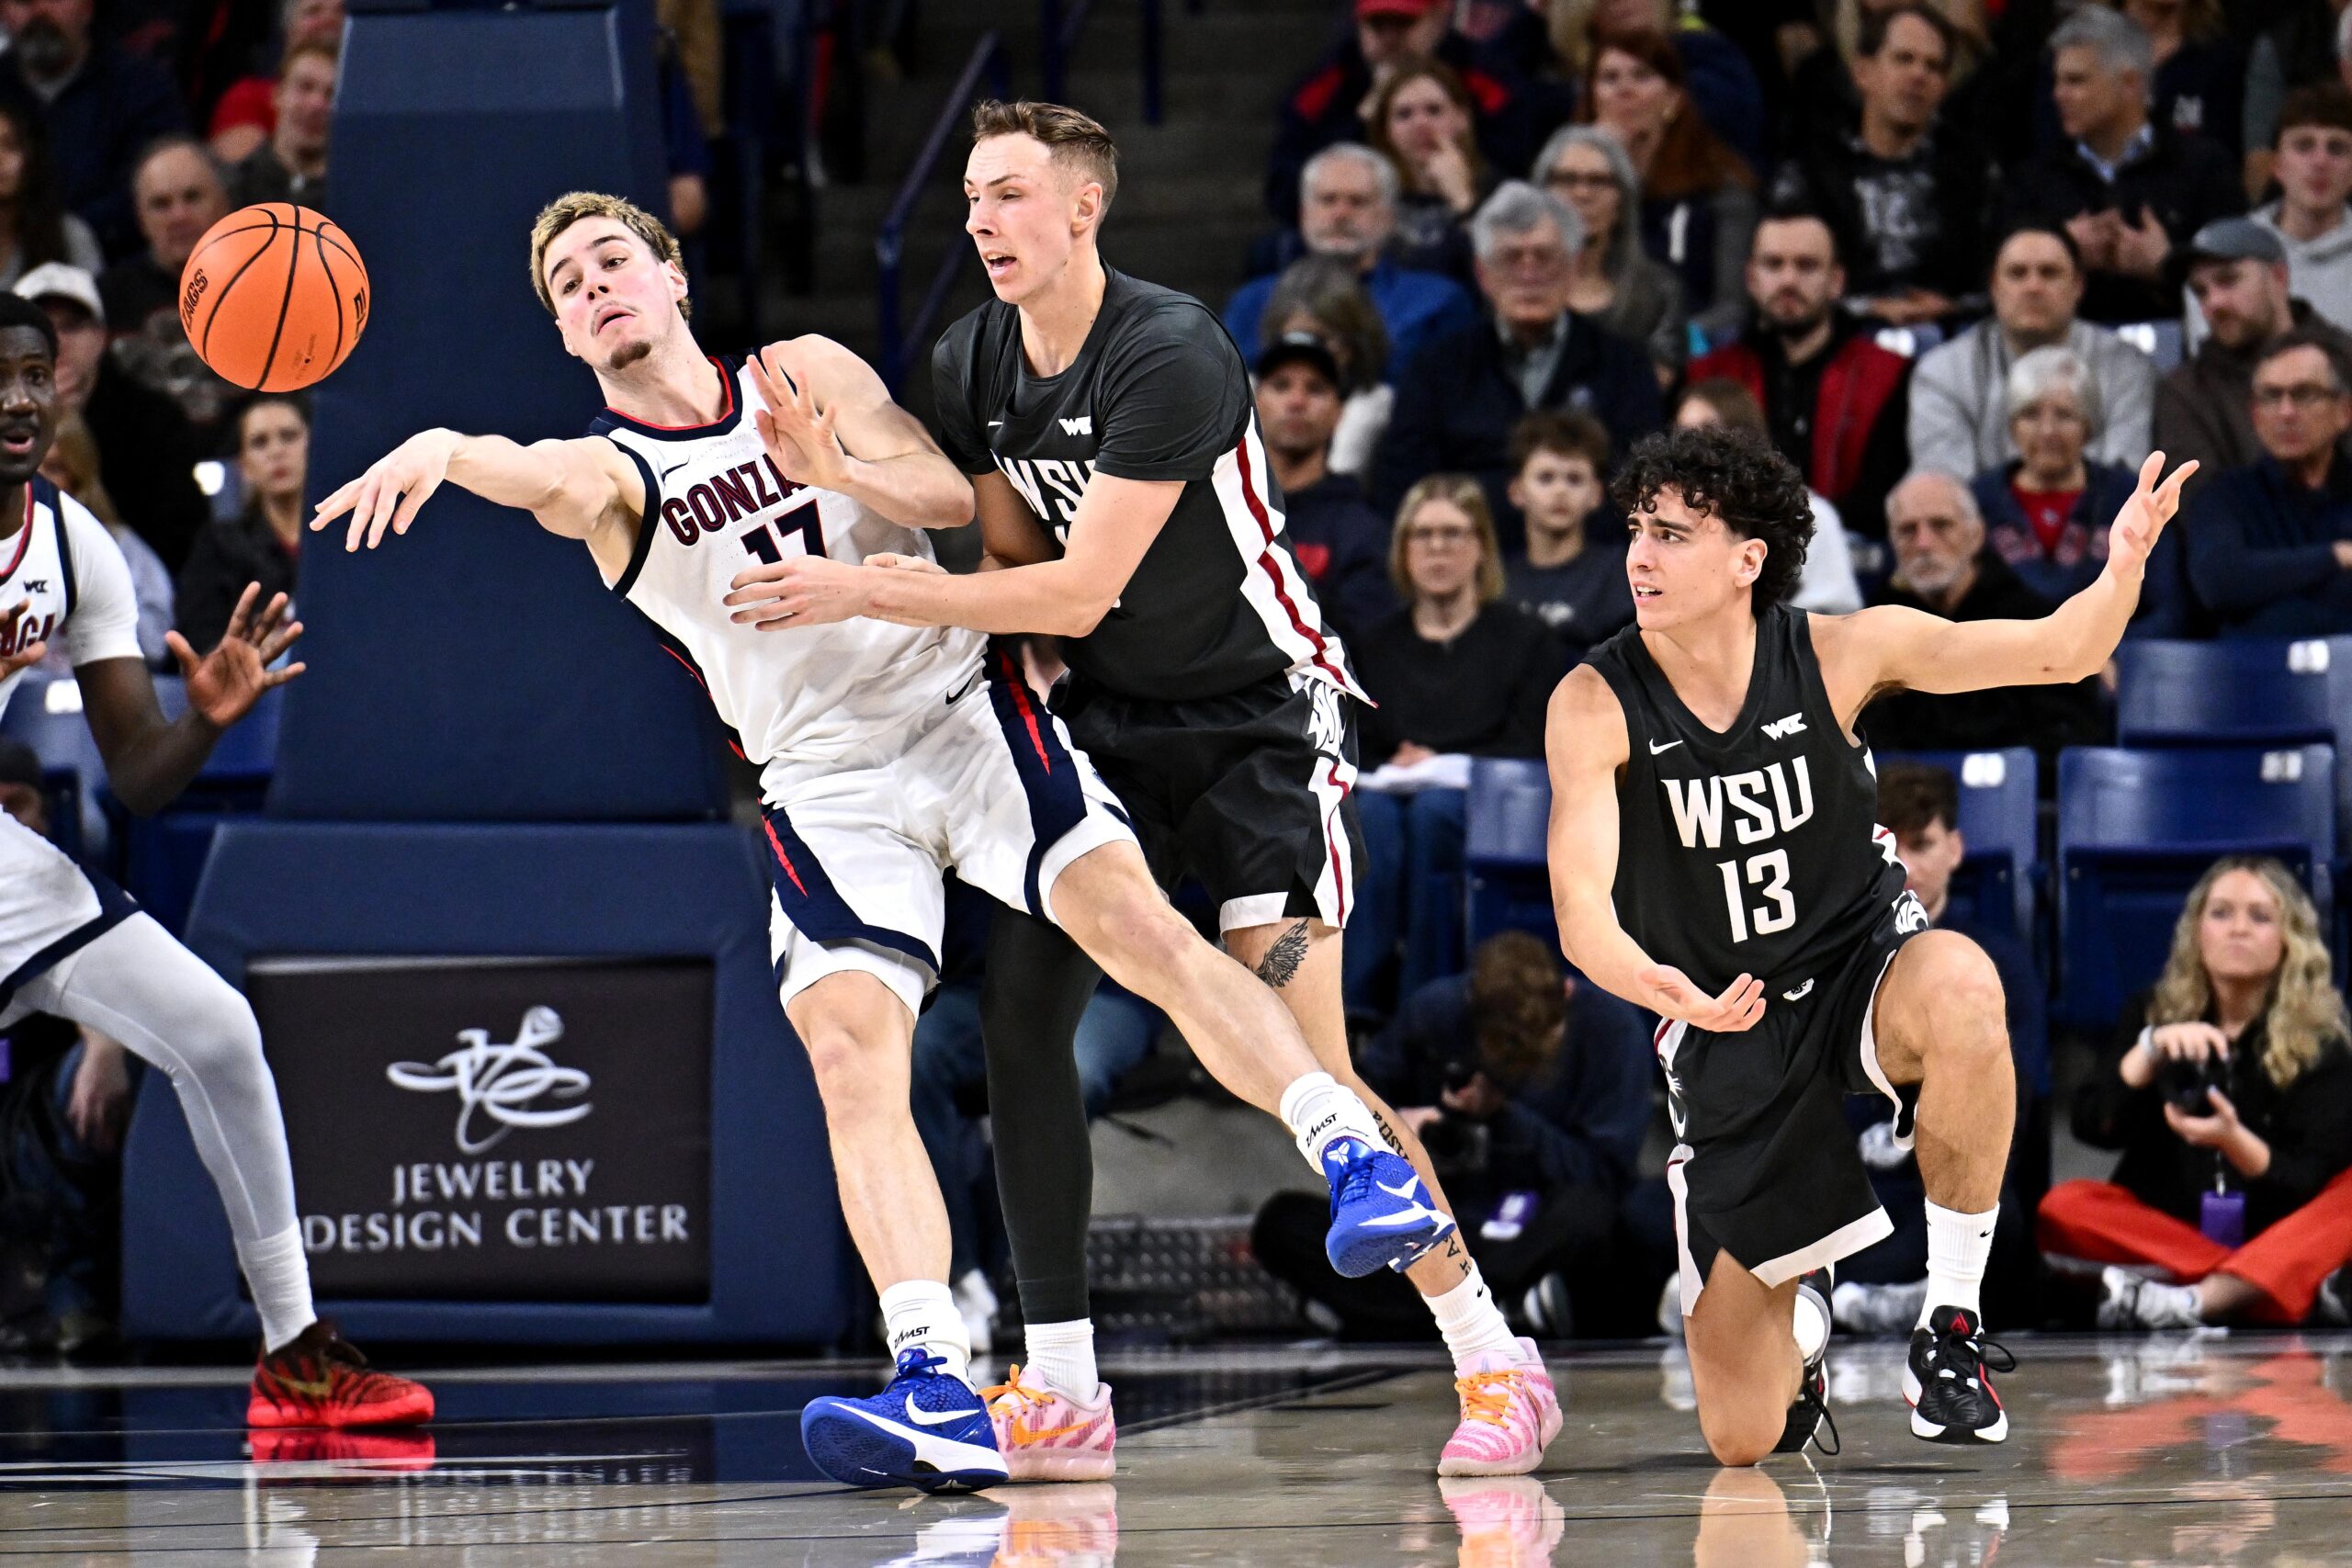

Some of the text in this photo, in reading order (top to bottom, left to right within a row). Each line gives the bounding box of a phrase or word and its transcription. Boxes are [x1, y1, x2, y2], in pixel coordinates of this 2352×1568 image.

[741, 499, 827, 565] 17
[1661, 755, 1814, 848] WSU
[1716, 849, 1795, 942] 13
[392, 1159, 594, 1207] JEWELRY
[304, 1204, 688, 1253] DESIGN CENTER
